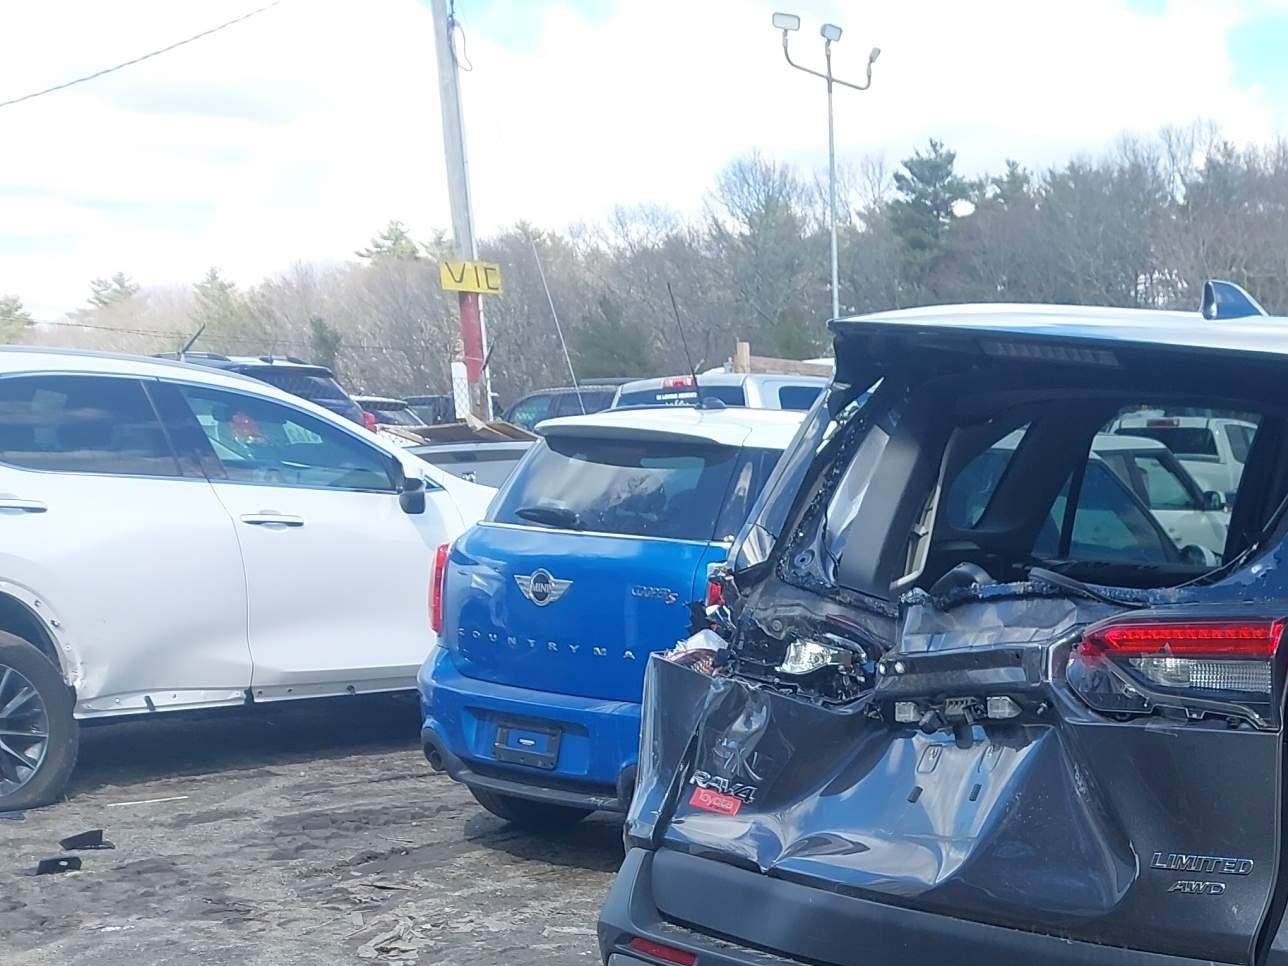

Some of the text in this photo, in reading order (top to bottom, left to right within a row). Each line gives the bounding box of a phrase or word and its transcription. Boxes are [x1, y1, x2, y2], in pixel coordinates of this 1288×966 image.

[458, 627, 637, 660] COUNTRYMA
[688, 769, 758, 804] RAV4
[1149, 852, 1254, 875] LIMITED
[1167, 880, 1226, 895] AWD
